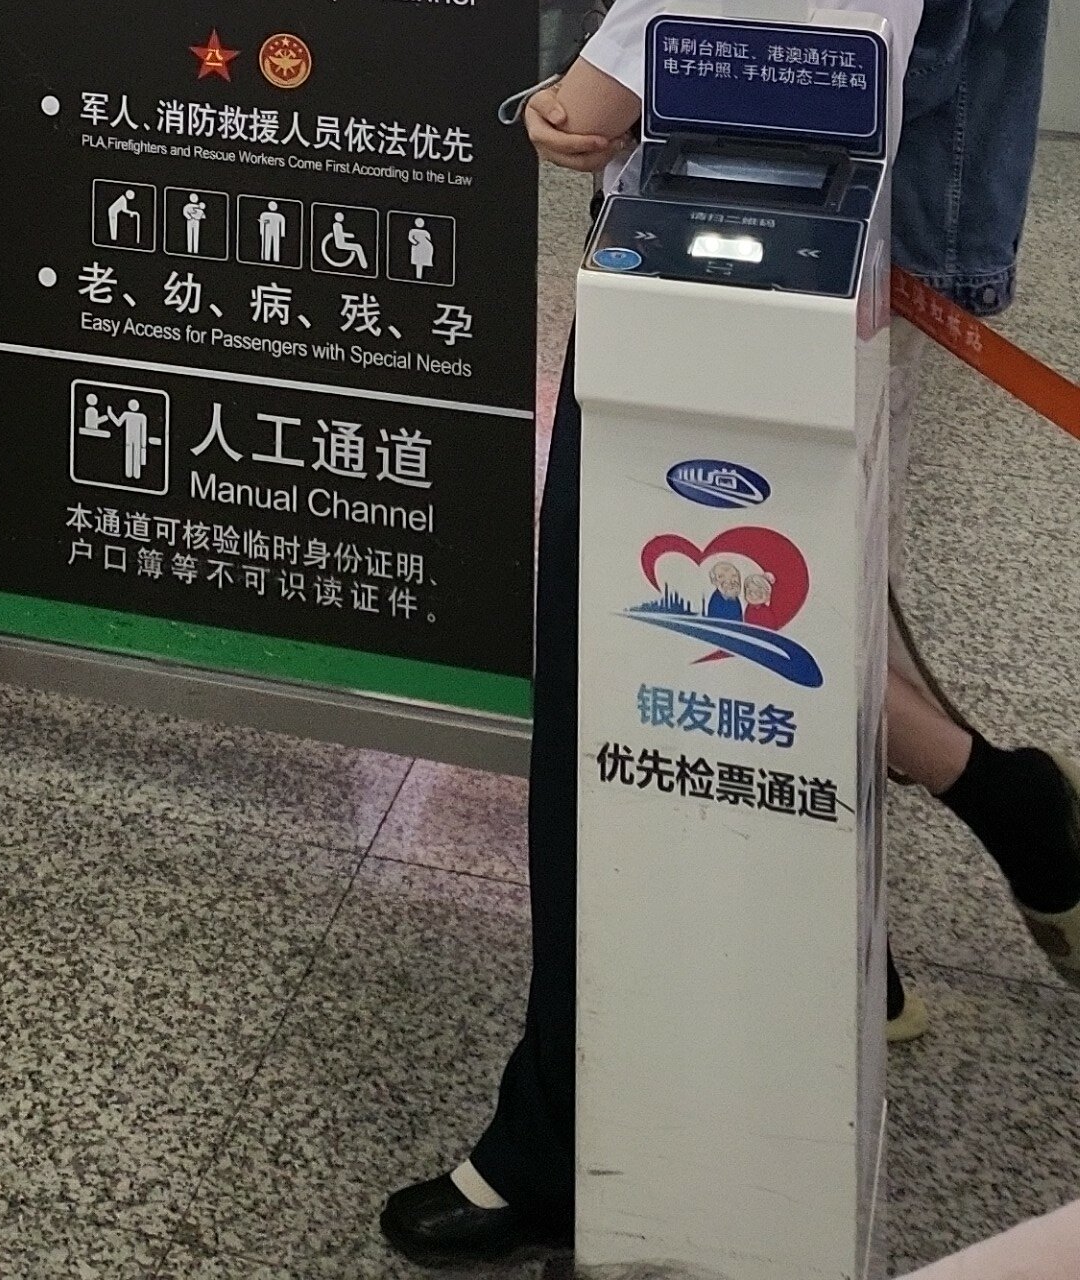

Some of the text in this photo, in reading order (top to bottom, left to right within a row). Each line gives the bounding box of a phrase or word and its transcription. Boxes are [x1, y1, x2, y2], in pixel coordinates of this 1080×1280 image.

[663, 36, 865, 70] 请刷台胞证、港澳通行证、
[663, 57, 868, 90] 电子护照、手机动态二维码
[80, 91, 474, 164] 军人、消防救援人员依法优先
[169, 144, 191, 158] and
[193, 146, 236, 162] Rescue
[238, 150, 286, 167] Workers
[288, 156, 323, 171] Come
[325, 159, 352, 174] First
[351, 163, 409, 183] According
[412, 168, 424, 181] to
[426, 170, 445, 184] the
[447, 172, 473, 187] Law
[77, 261, 474, 347] 老、幼、病、残、孕
[81, 312, 473, 378] Easy Access for Passengers with Special Needs
[190, 402, 434, 489] 人工通道
[190, 470, 434, 533] Manual Channel
[66, 502, 440, 587] 本通道可核验临时身份证明、
[67, 538, 438, 624] 户口簿等不可识读证件。
[636, 682, 798, 749] 银发服务
[596, 741, 839, 823] 优先检票通道
